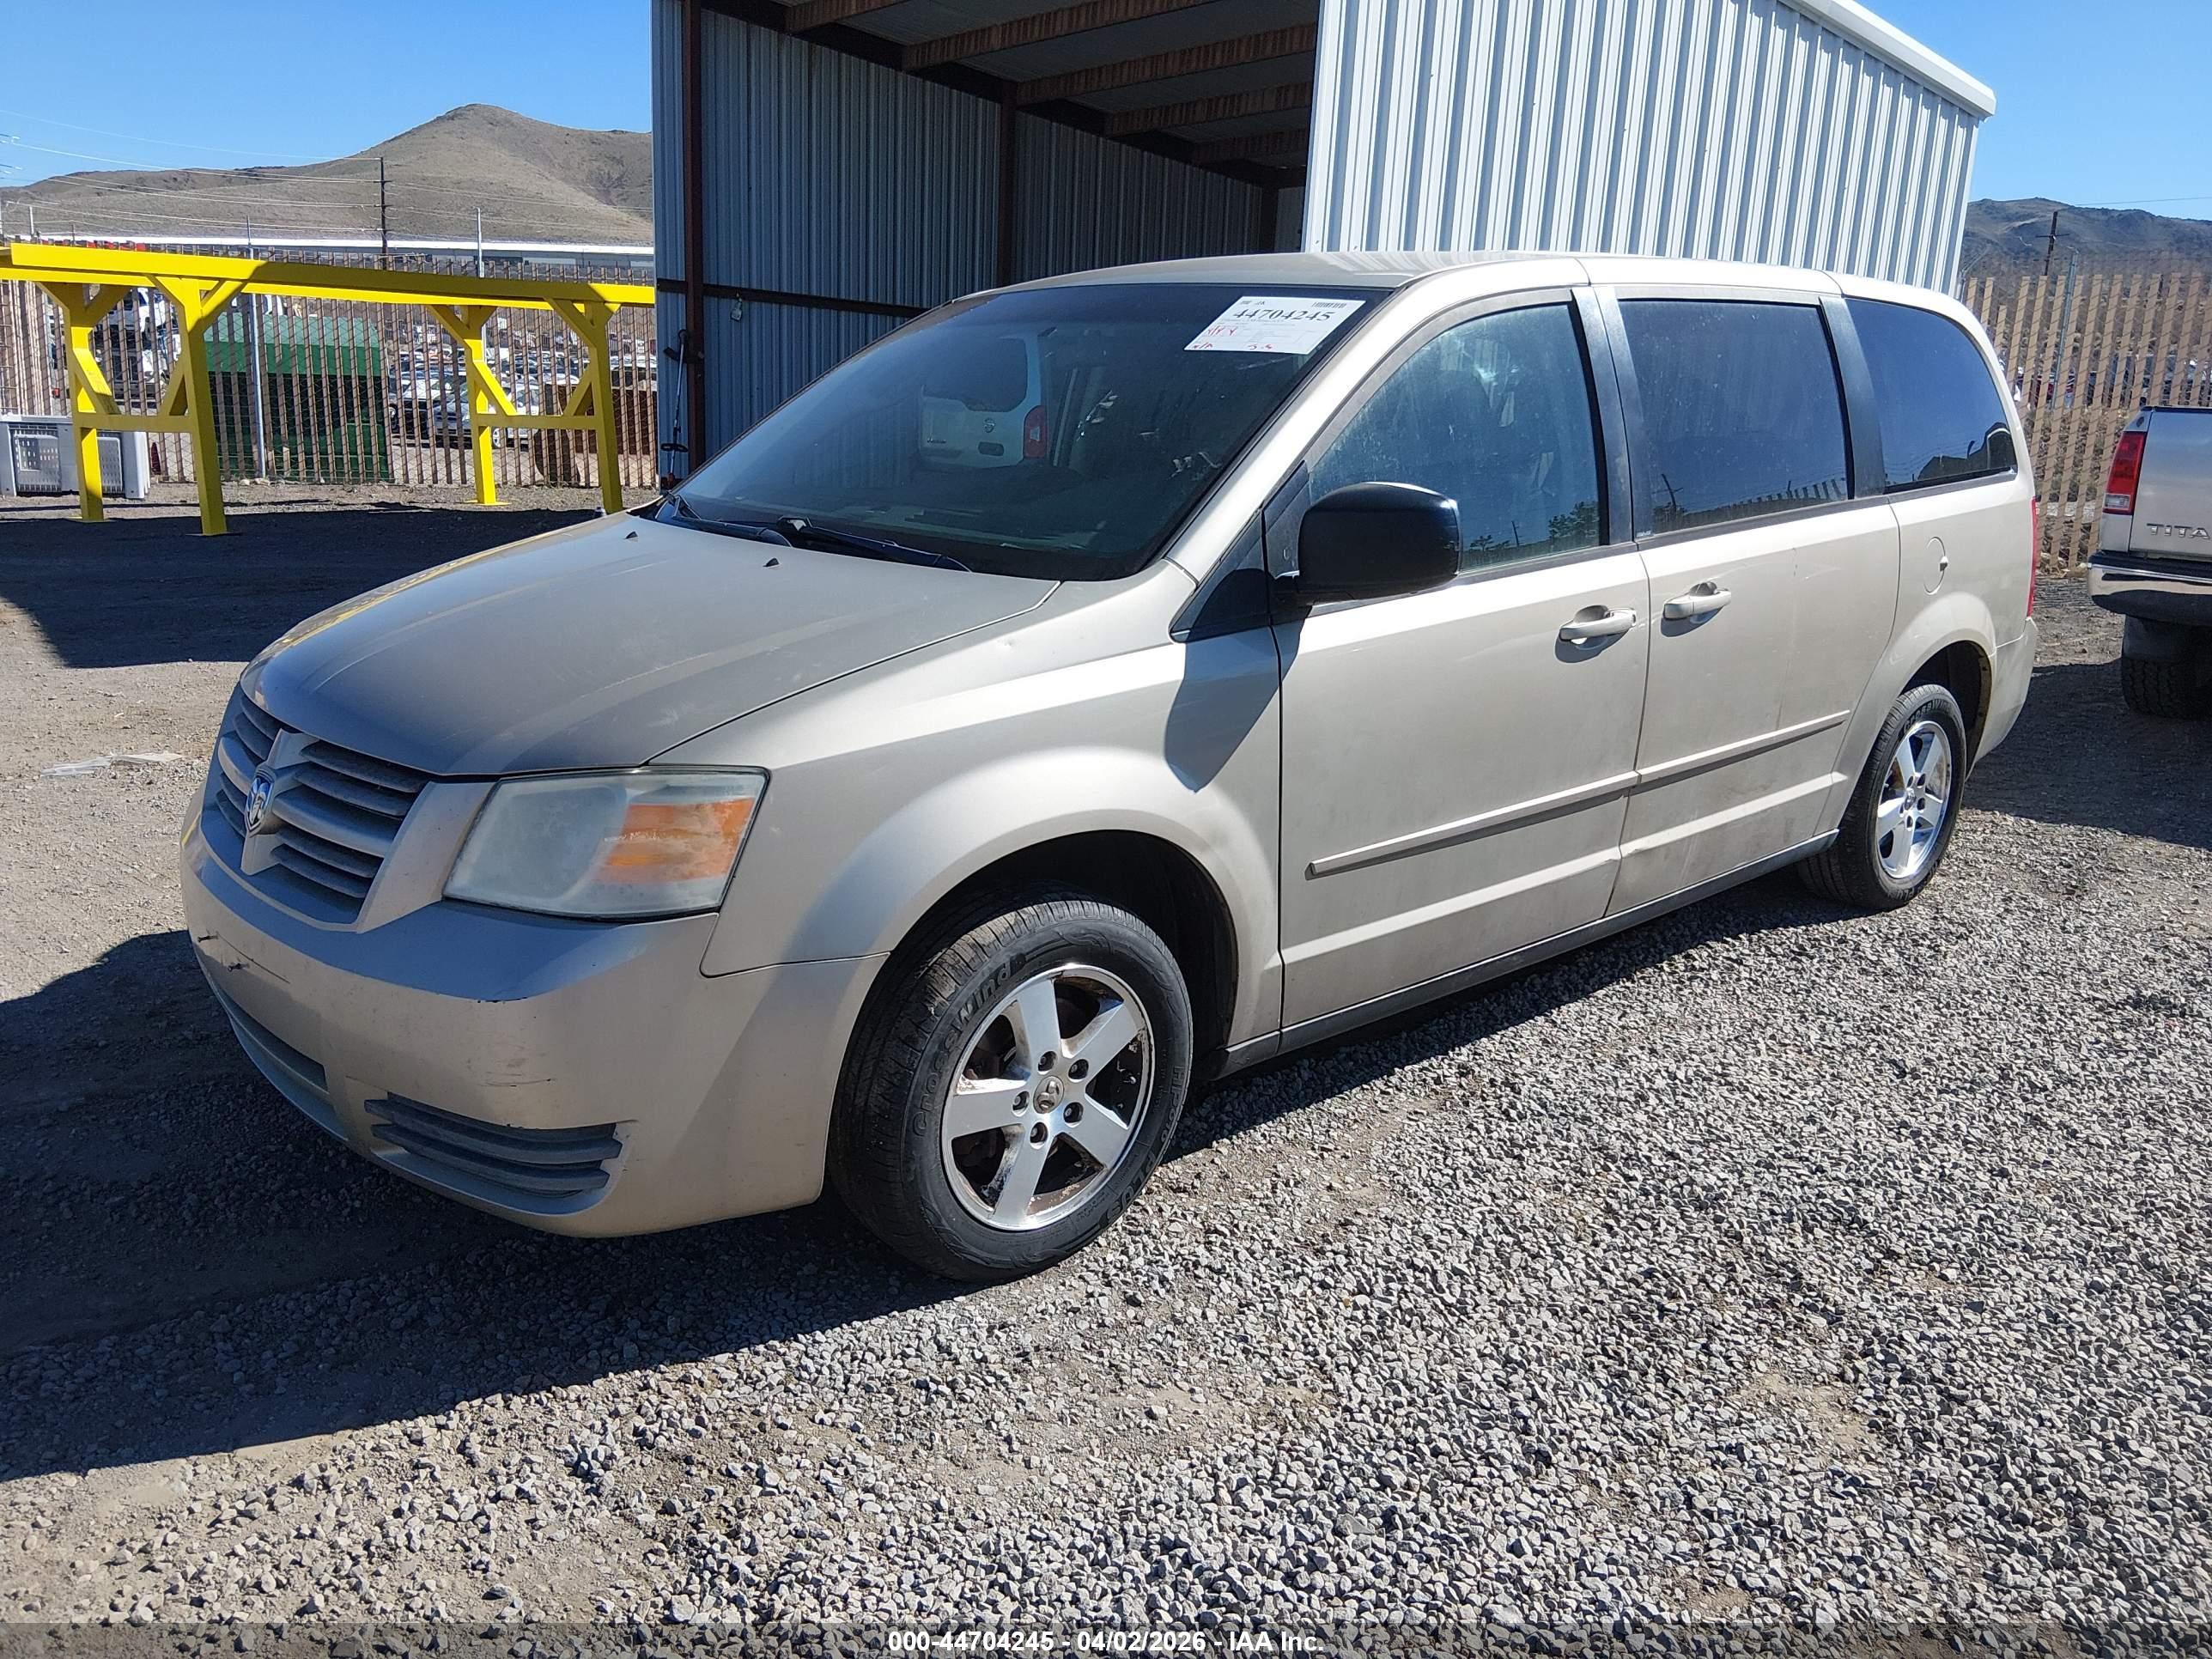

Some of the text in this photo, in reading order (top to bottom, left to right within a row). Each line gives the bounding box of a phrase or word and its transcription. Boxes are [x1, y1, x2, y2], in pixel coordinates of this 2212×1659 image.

[1233, 308, 1336, 321] 44704245
[2146, 523, 2211, 539] TITA
[1106, 1151, 1157, 1221] PLUS
